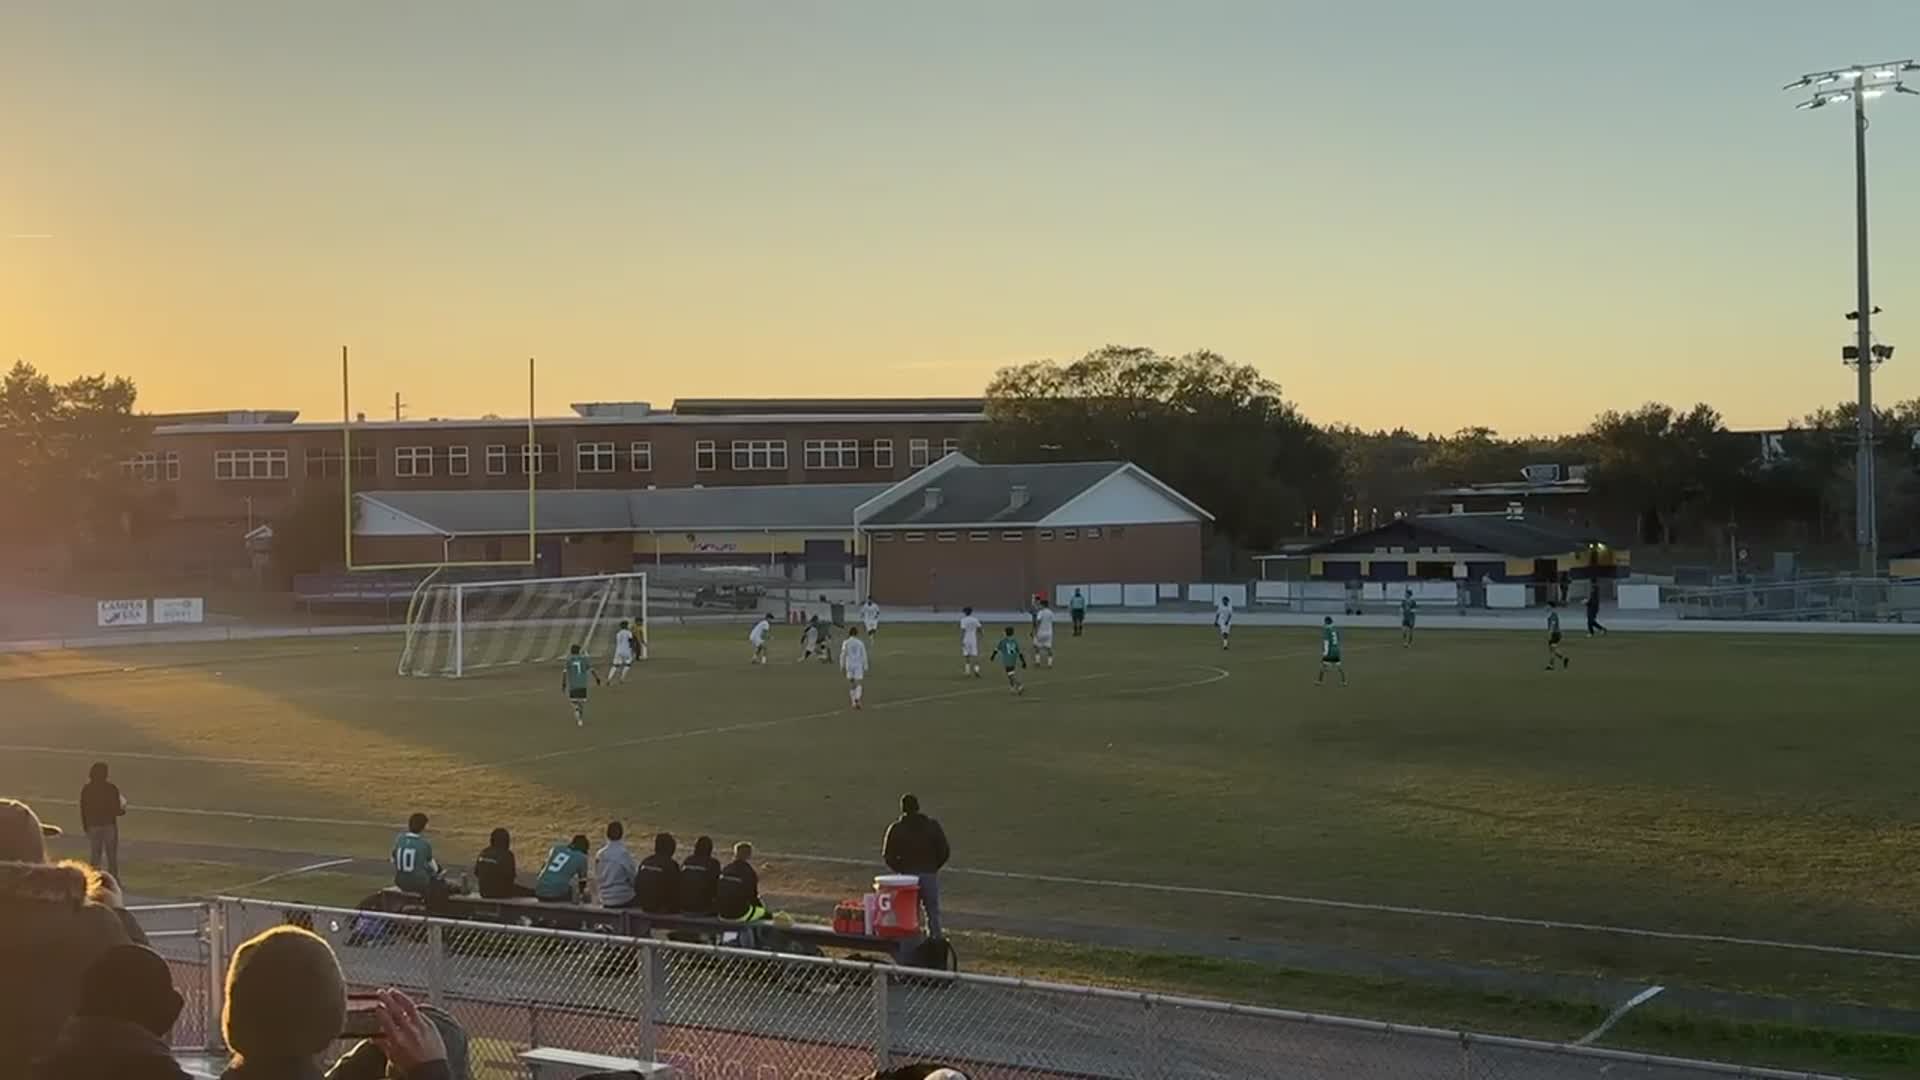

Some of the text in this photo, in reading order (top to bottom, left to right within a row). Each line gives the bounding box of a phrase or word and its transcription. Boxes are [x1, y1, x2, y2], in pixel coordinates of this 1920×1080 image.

[397, 847, 416, 872] 10
[550, 852, 569, 872] 9
[879, 894, 891, 911] G
